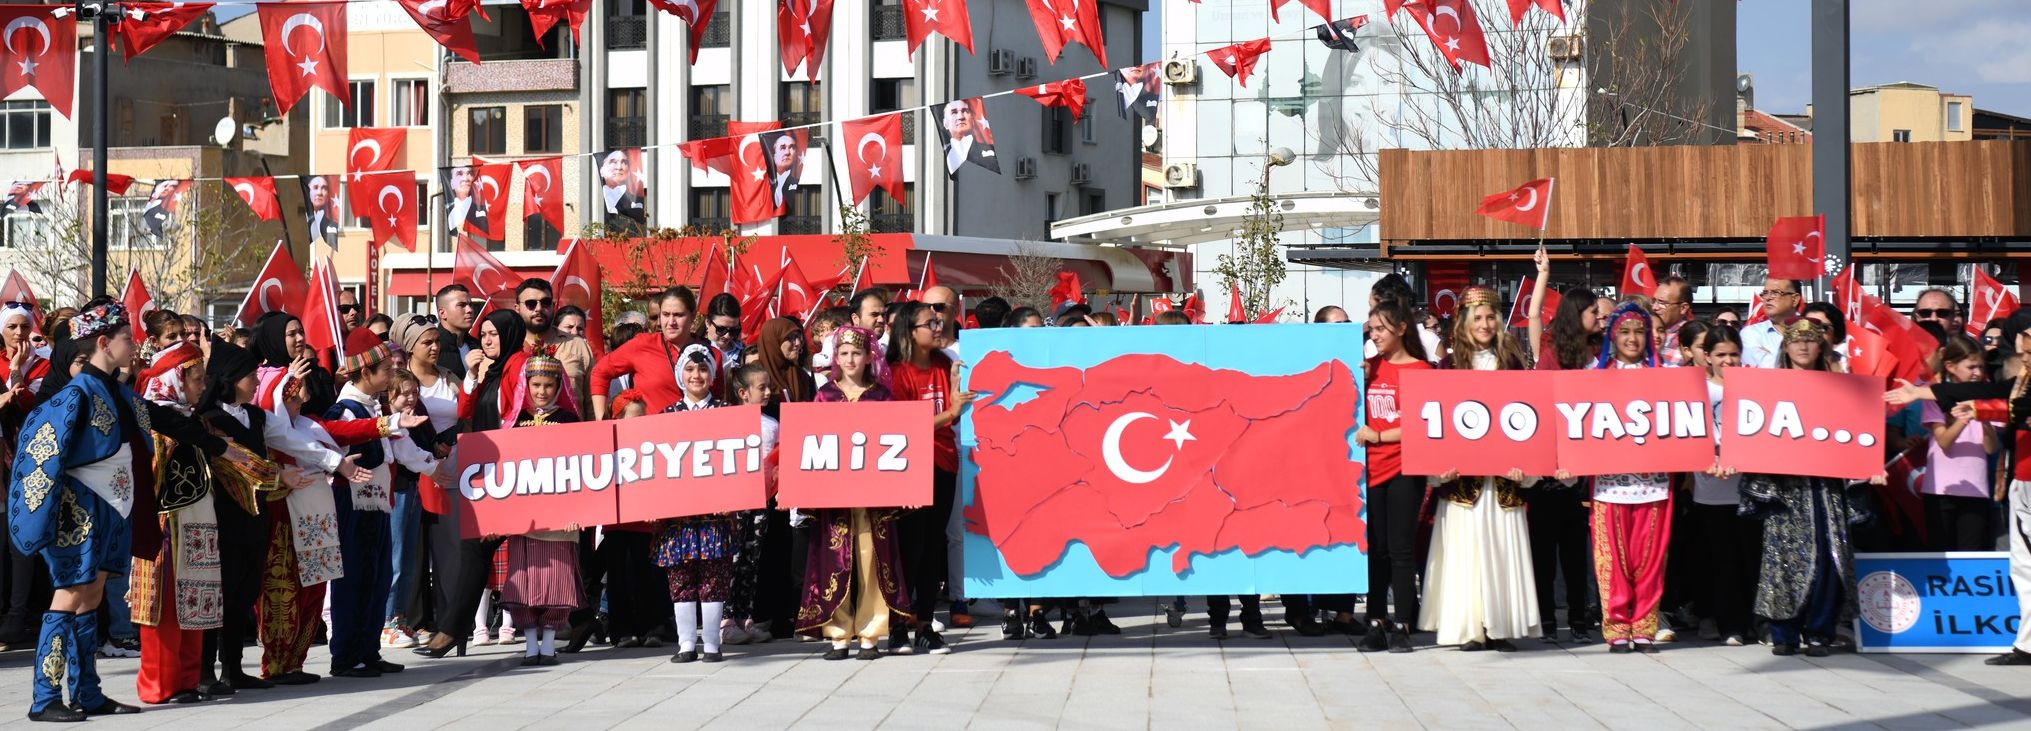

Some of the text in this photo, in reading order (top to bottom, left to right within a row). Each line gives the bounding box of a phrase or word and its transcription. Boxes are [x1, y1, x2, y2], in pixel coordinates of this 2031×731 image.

[1420, 399, 1876, 447] 100 YAŞIN DA...
